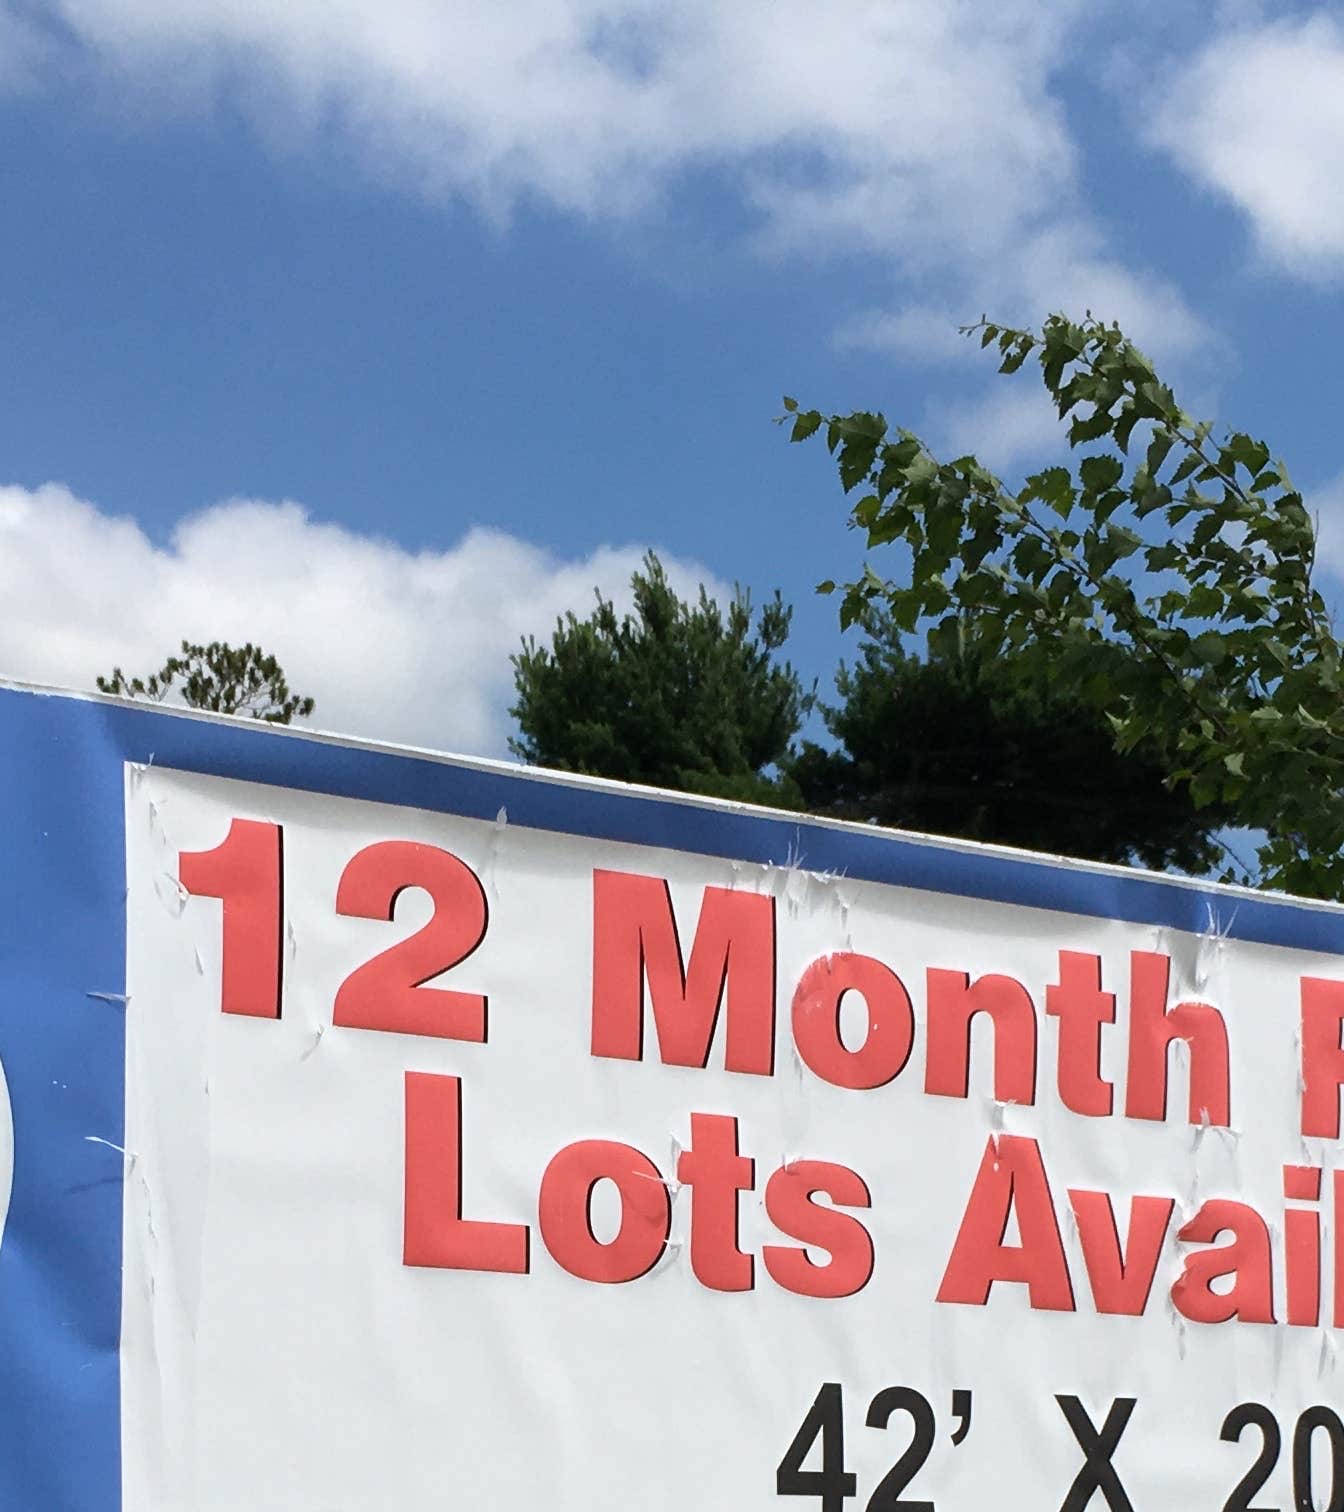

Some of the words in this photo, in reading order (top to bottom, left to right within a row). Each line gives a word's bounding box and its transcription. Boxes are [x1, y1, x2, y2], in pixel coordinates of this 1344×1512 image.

[179, 817, 489, 1045] 12
[591, 868, 1233, 1128] Month
[403, 1070, 876, 1299] Lots
